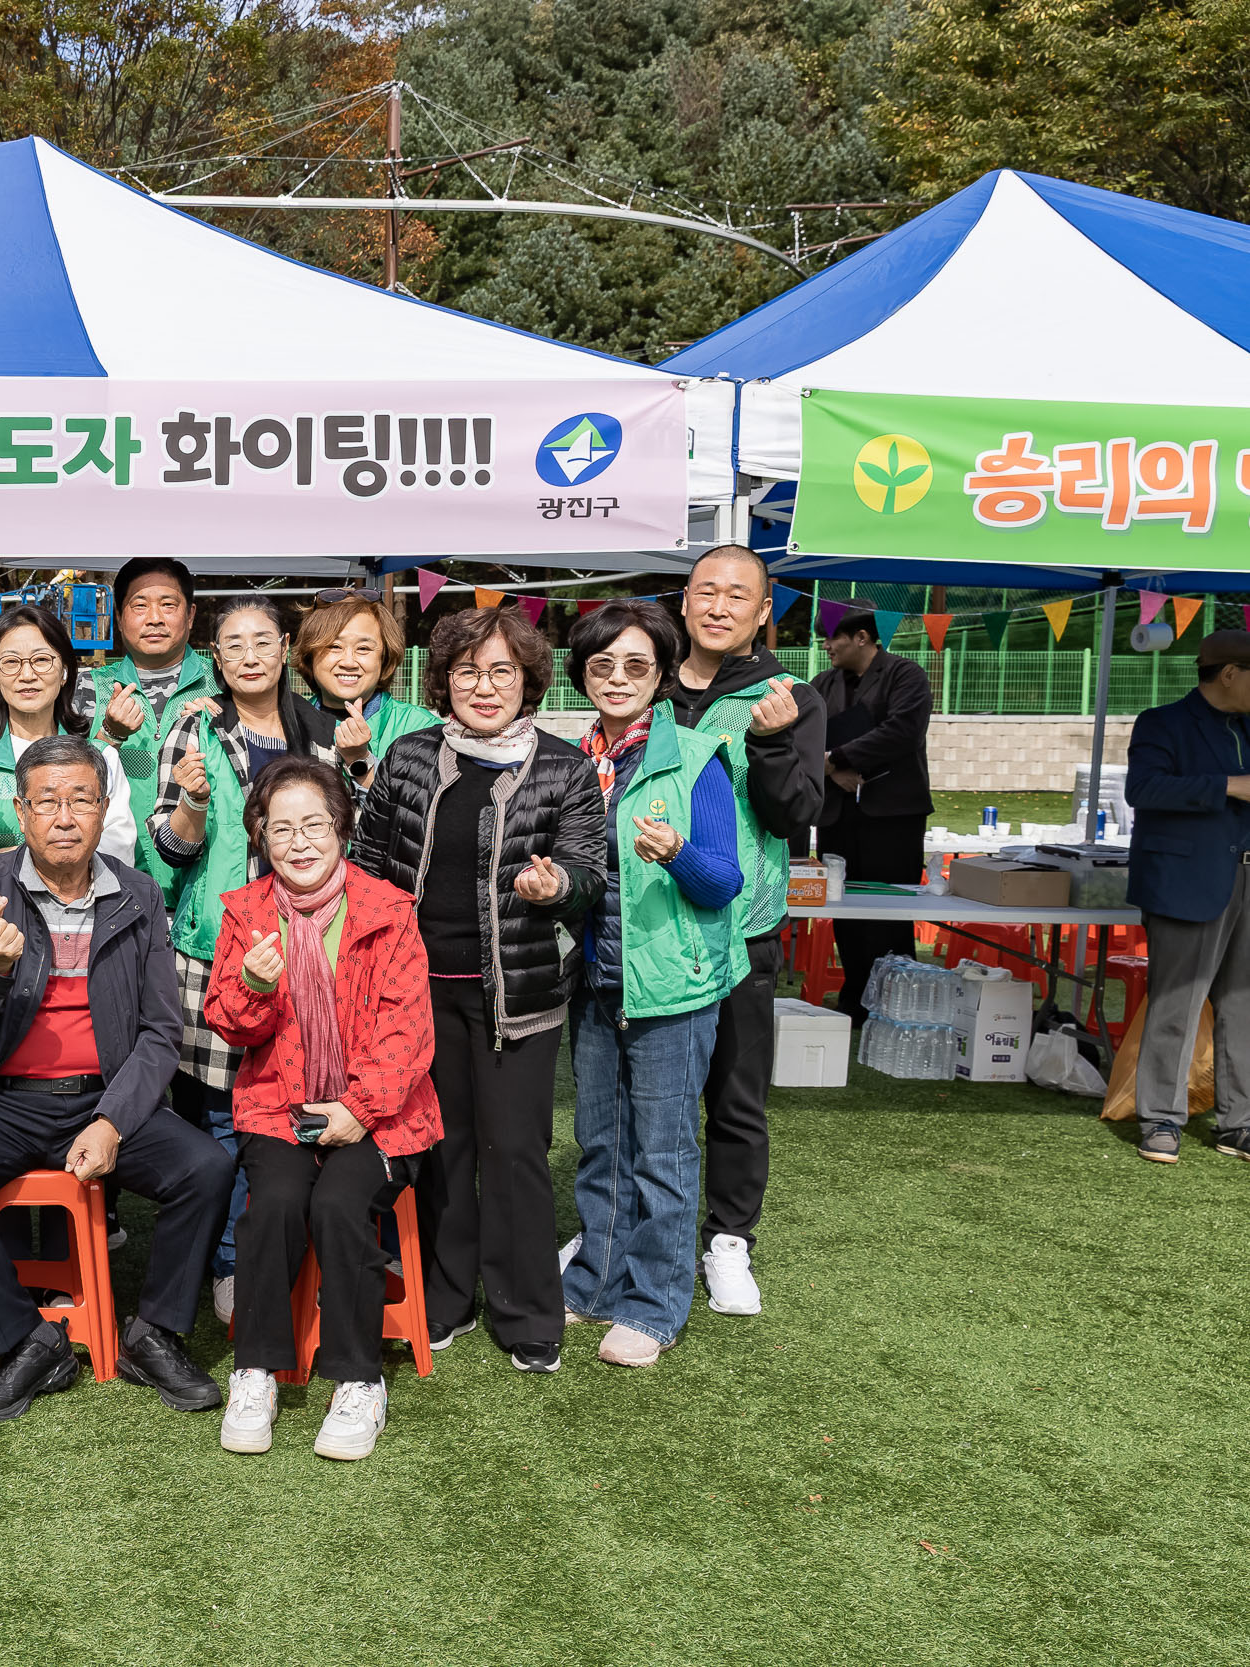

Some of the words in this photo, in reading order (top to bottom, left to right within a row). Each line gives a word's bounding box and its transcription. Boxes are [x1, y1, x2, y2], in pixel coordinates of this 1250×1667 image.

[160, 410, 493, 499] 화이팅!!!!
[967, 434, 1215, 530] 승리의
[536, 496, 621, 520] 광진구
